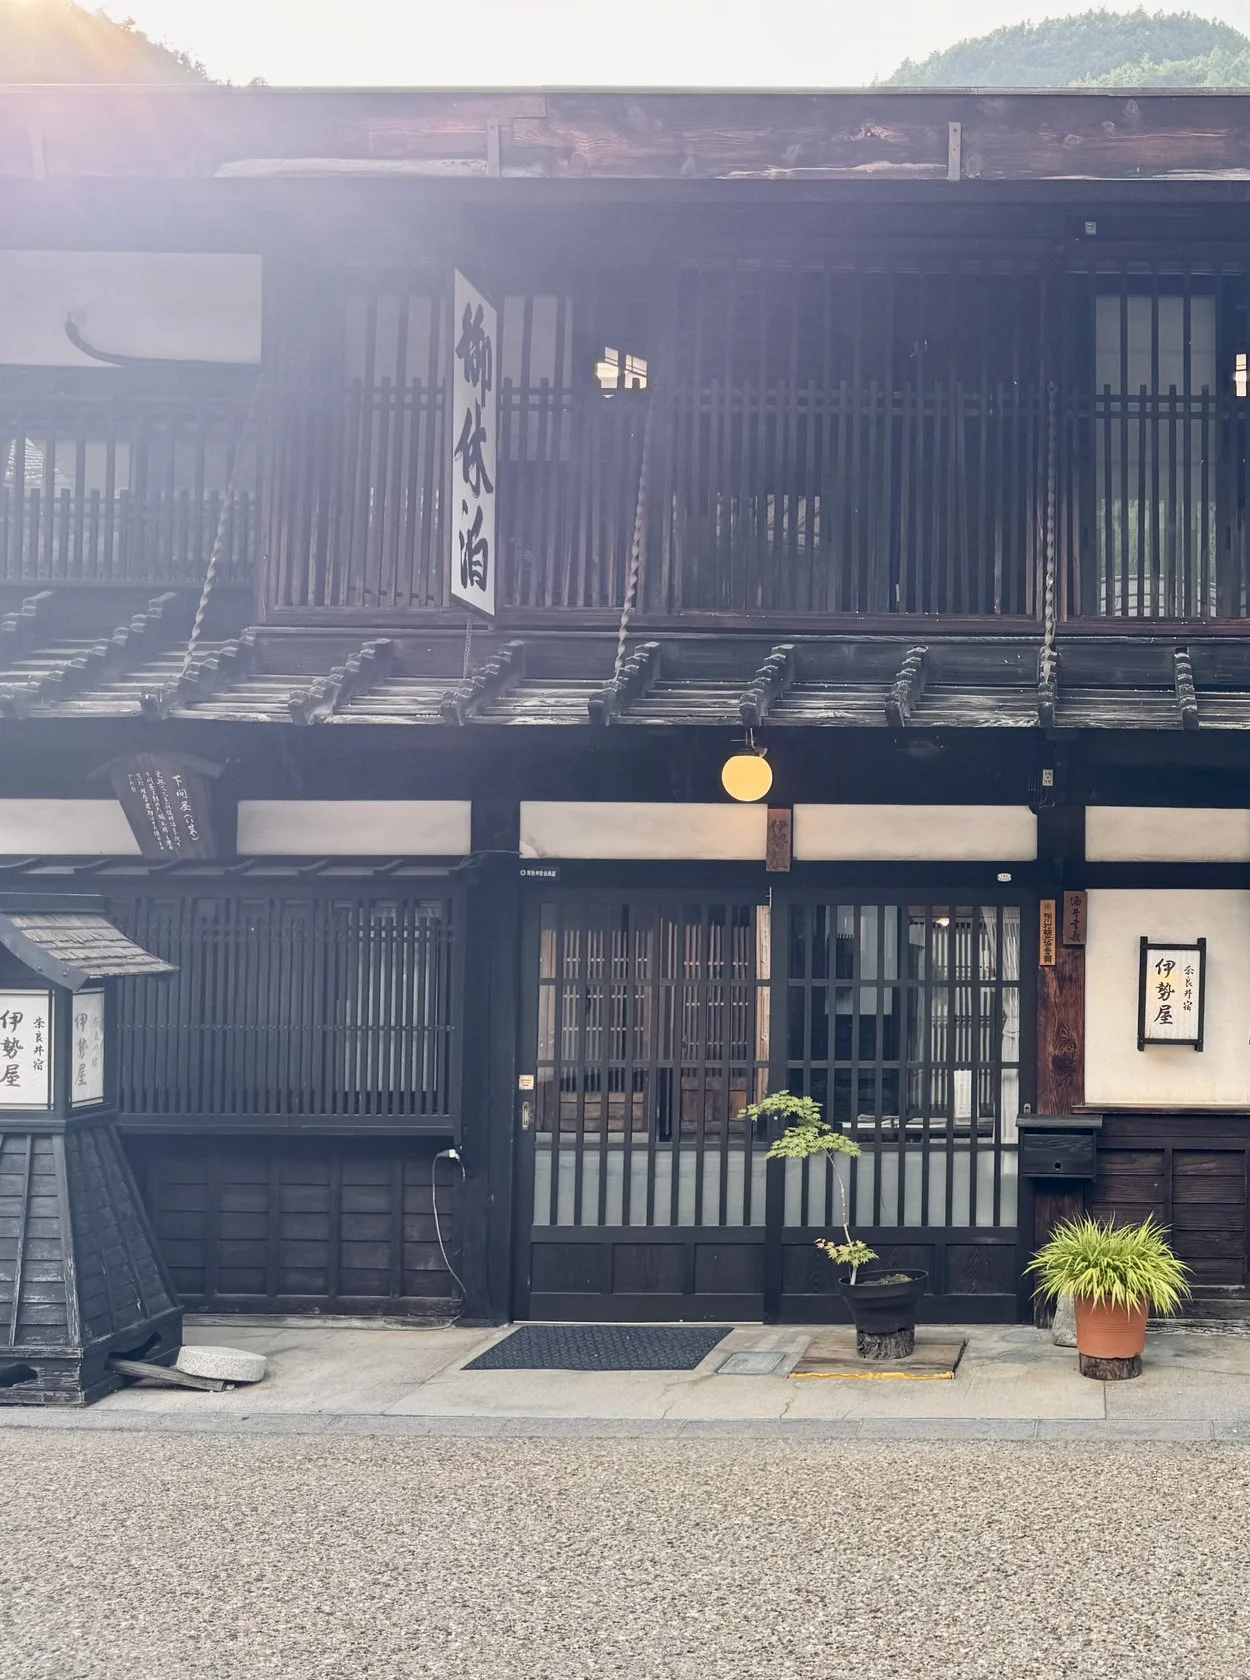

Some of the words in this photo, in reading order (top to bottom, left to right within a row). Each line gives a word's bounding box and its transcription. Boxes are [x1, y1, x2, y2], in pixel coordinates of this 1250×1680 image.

[1154, 958, 1176, 1025] 伊勢屋
[1183, 965, 1194, 1012] 奈良井宿
[0, 1010, 24, 1087] 伊勢屋
[33, 1016, 45, 1071] 奈良井宿
[74, 1011, 88, 1087] 伊勢屋
